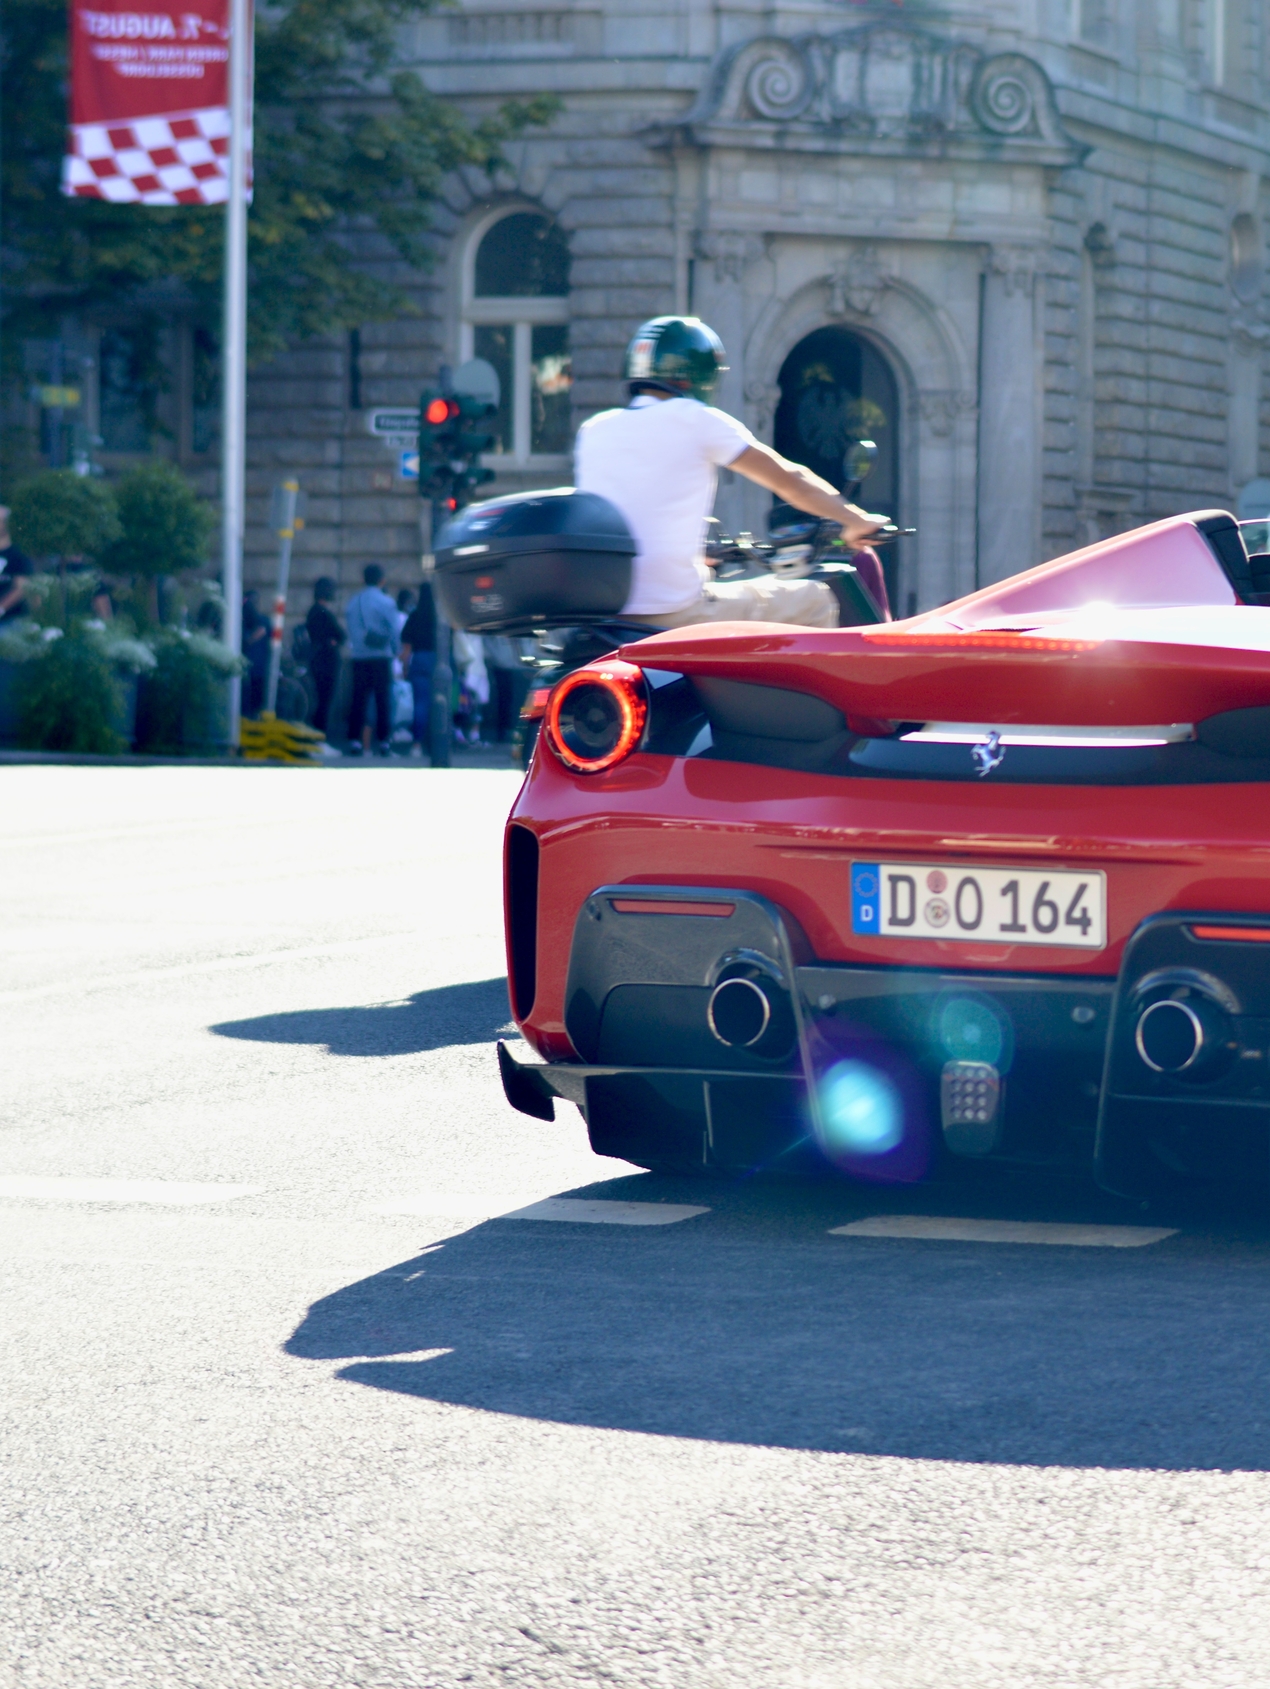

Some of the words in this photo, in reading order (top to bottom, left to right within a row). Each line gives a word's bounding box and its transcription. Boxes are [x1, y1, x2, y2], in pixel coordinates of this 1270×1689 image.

[861, 905, 873, 921] D
[888, 874, 916, 927] D
[1000, 880, 1092, 936] 164
